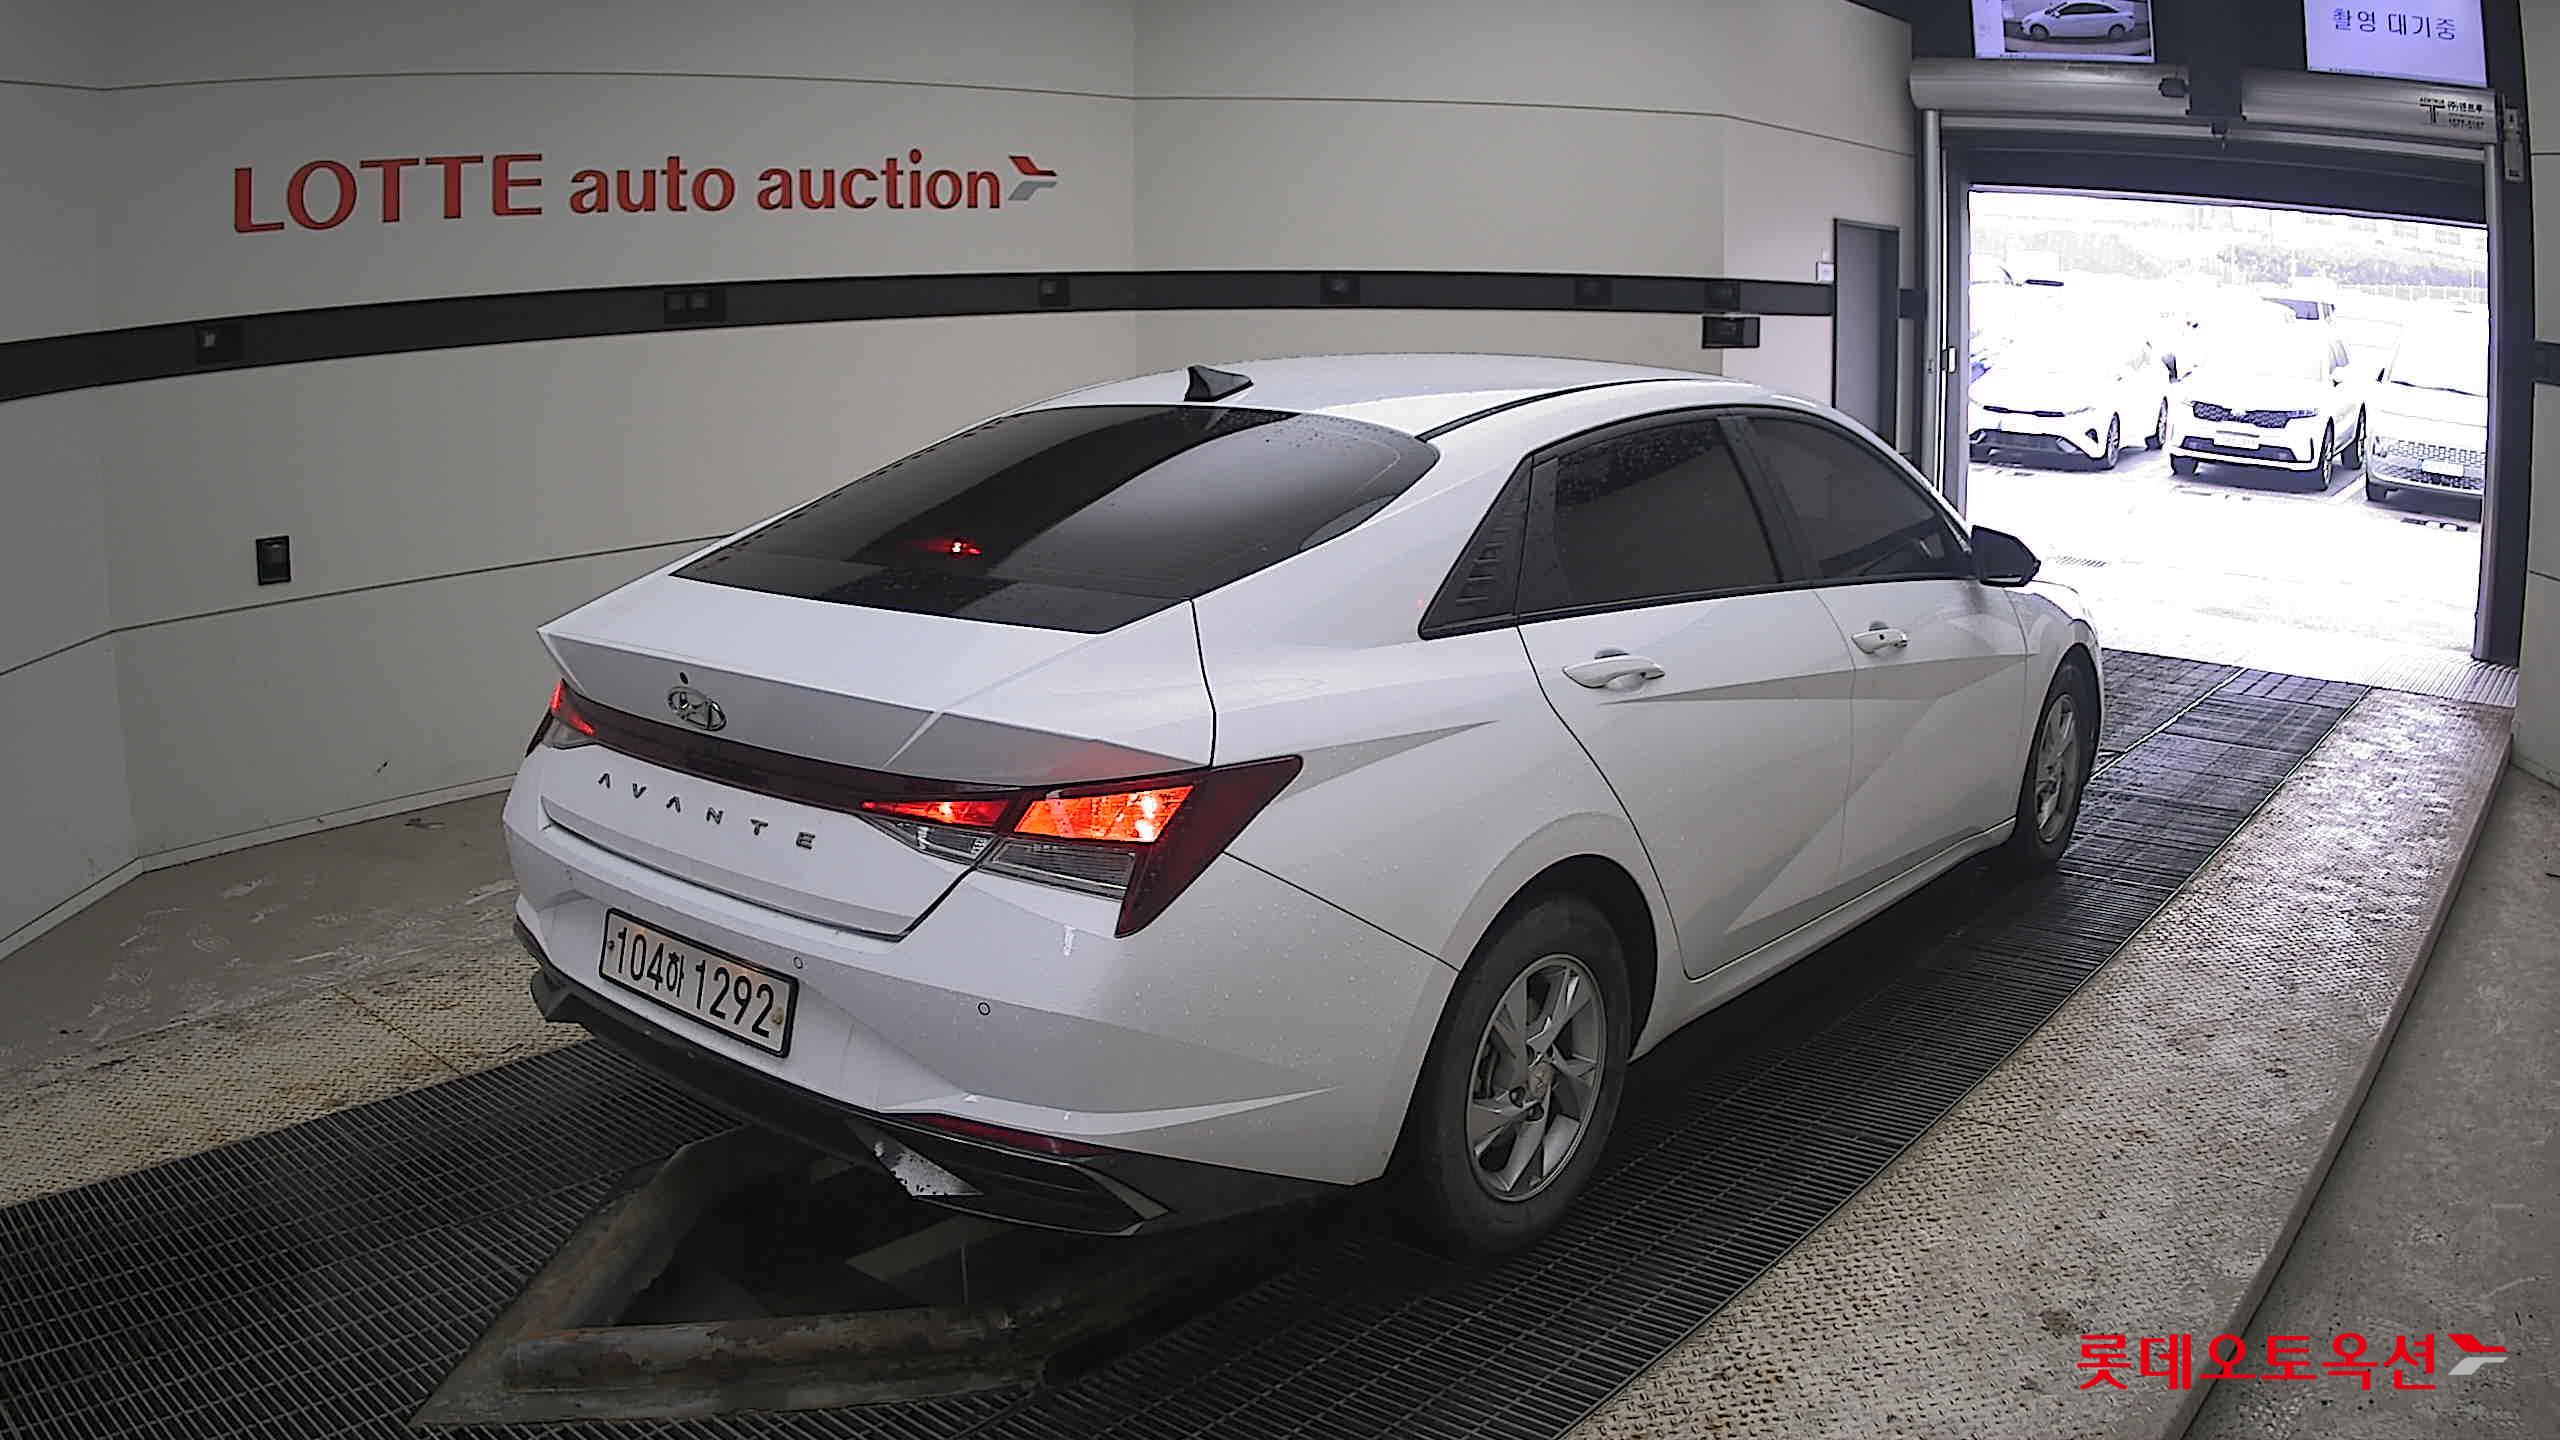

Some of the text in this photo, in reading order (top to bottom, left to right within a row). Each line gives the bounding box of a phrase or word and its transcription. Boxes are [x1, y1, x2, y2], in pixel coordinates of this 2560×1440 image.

[2334, 8, 2456, 41] 촬영 대기중
[235, 149, 1001, 233] LOTTE auto auction
[599, 773, 815, 850] AVANTE
[618, 927, 773, 1038] 104하 1292
